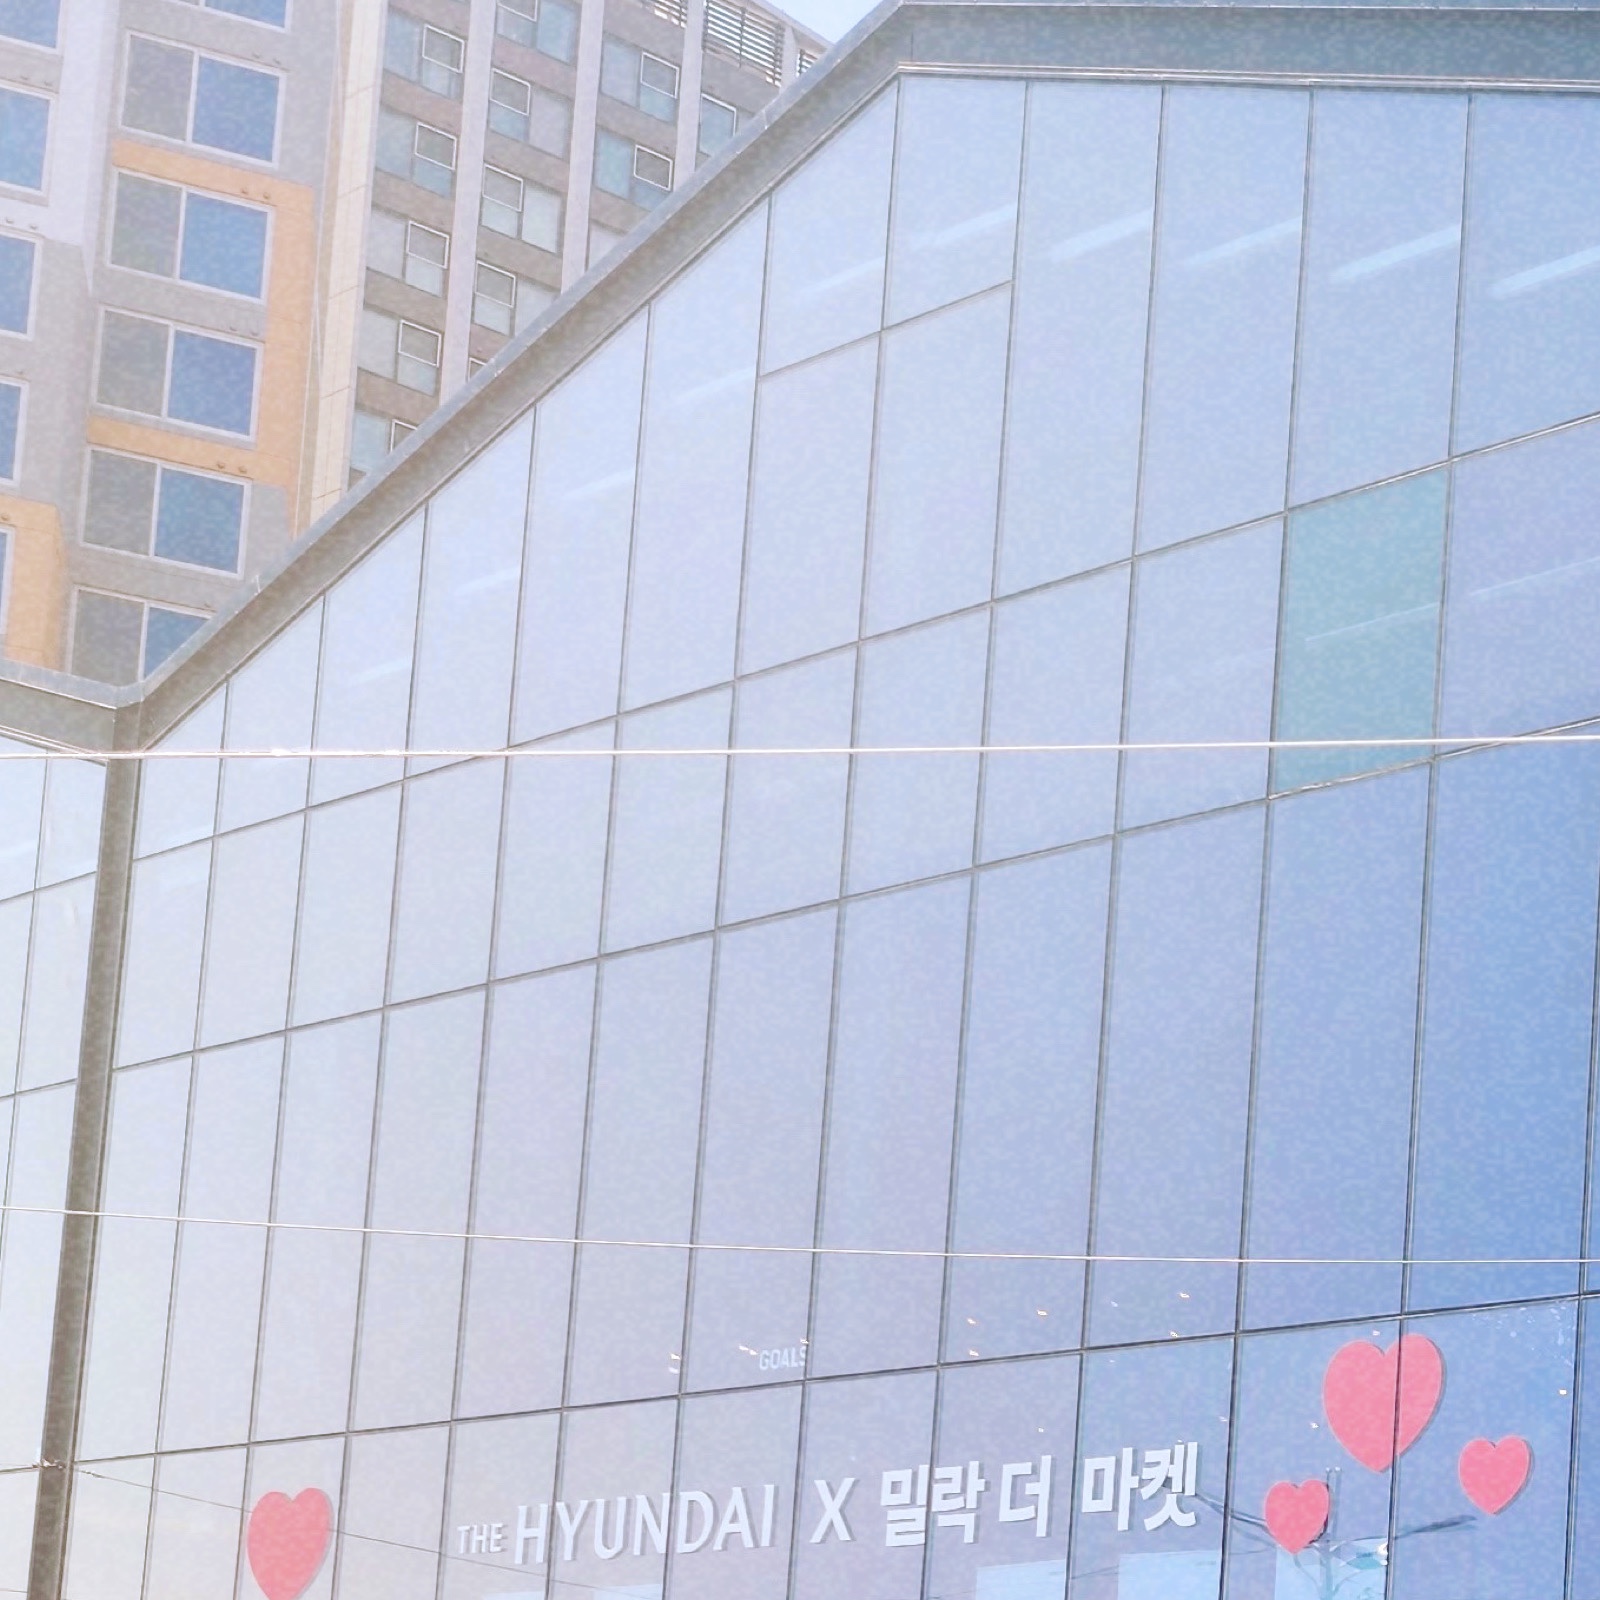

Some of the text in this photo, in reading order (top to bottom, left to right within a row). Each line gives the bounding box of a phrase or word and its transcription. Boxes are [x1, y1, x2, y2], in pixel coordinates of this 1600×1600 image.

[759, 1346, 806, 1371] GOALS
[457, 1441, 1199, 1565] THE HYUNDAI X 밀락 더 마켓
